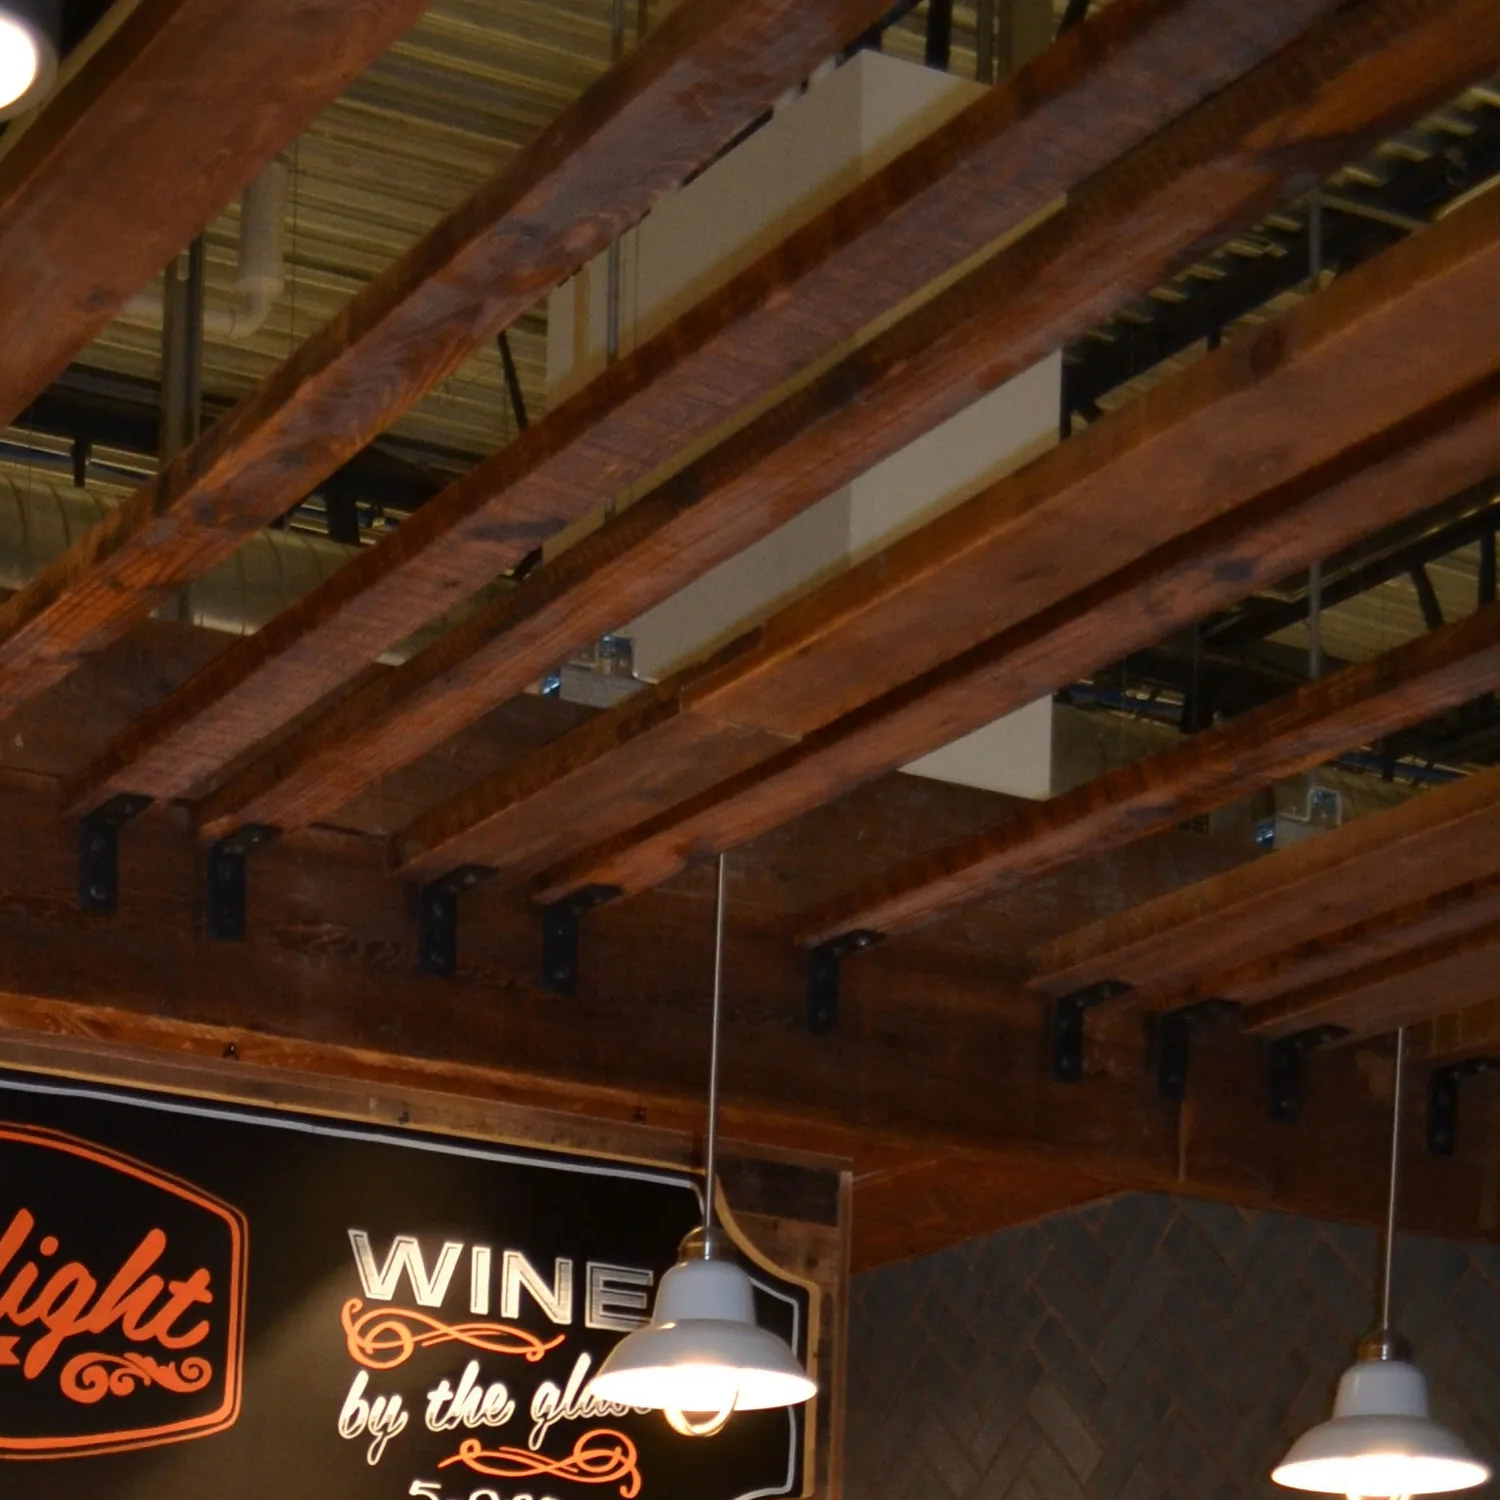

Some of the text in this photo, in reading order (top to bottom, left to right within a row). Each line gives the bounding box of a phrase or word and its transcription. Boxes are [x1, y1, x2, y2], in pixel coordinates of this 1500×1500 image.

[348, 1228, 655, 1333] WINE
[338, 1371, 409, 1465] by
[425, 1360, 514, 1431] the
